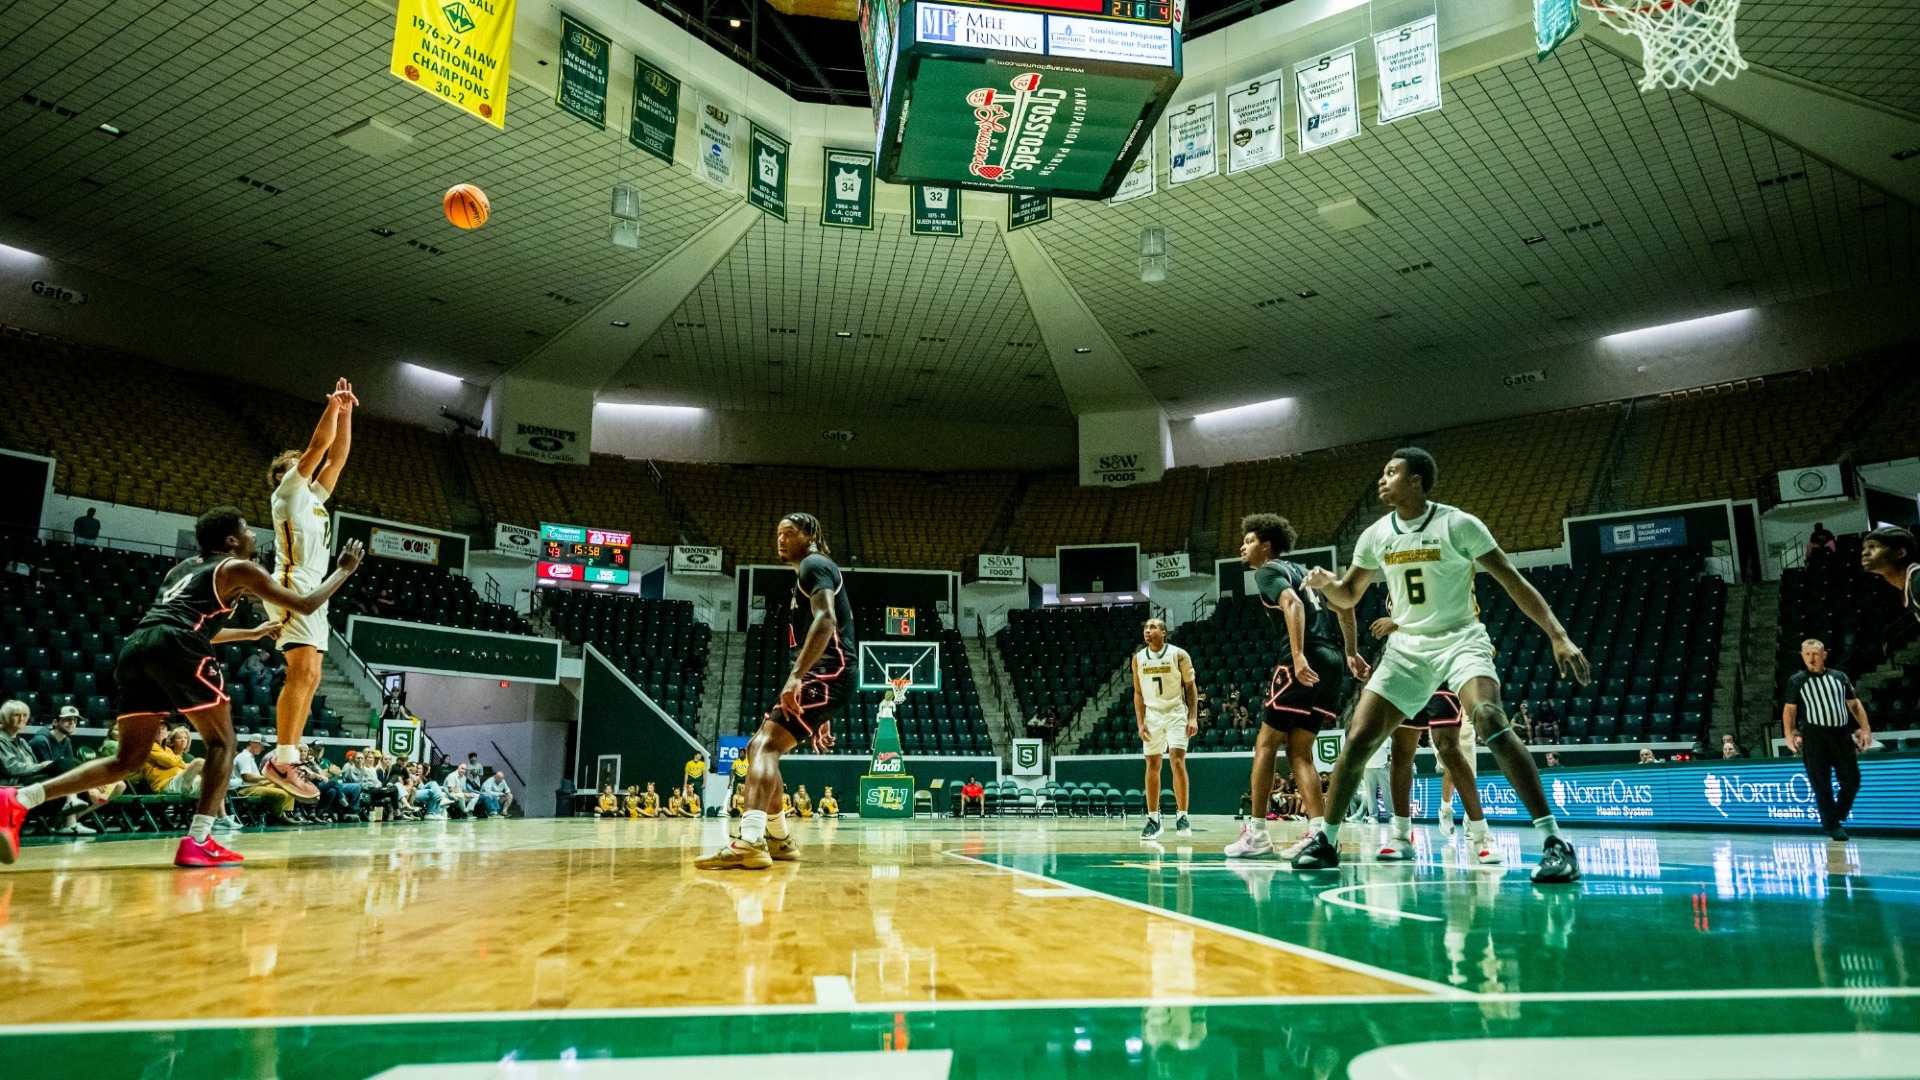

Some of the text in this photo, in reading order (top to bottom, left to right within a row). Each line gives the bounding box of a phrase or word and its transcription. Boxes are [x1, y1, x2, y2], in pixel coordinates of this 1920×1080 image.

[1112, 2, 1131, 17] 21
[1136, 4, 1145, 18] 0
[1160, 7, 1168, 19] 4
[966, 28, 1037, 49] PRINTING
[1399, 27, 1412, 42] S
[413, 15, 497, 70] 1976-77 AIAW
[422, 38, 484, 81] NATIONAL
[1382, 43, 1432, 62] Southeastern
[1389, 52, 1425, 66] Women's
[567, 50, 602, 75] Women's
[1318, 57, 1331, 71] S
[1389, 58, 1426, 73] Volleyball
[413, 52, 490, 100] CHAMPIONS
[563, 58, 605, 84] Basketball
[1248, 82, 1260, 95] S
[1301, 71, 1350, 92] Southeastern
[1309, 80, 1343, 95] Women's
[1391, 75, 1422, 91] SLC
[436, 81, 465, 104] 30-2
[1308, 86, 1344, 102] Volleyball
[1398, 94, 1419, 105] 2024
[642, 93, 672, 115] Women's
[1186, 104, 1196, 115] S
[1232, 96, 1277, 114] Southeastern
[637, 99, 675, 124] Basketball
[1238, 111, 1272, 126] Volleyball
[1239, 106, 1270, 119] Women's
[1172, 114, 1212, 130] Southeastern
[1179, 124, 1206, 134] Women's
[704, 122, 731, 141] Women's
[1011, 88, 1067, 171] Crossroads
[1039, 87, 1087, 176] TANGIPAHOA PARISH
[1177, 129, 1207, 142] Volleyball
[1255, 125, 1275, 136] SLC
[1320, 128, 1338, 139] 2023
[1246, 146, 1264, 156] 2023
[764, 164, 774, 177] 21
[1186, 166, 1201, 175] 2022
[842, 183, 854, 192] 34
[930, 192, 943, 201] 32
[32, 281, 88, 305] Gate 3
[1503, 370, 1547, 386] Gate 1
[517, 424, 576, 442] RONNIE'S
[822, 431, 856, 440] Gate 2
[1100, 455, 1138, 469] S&W
[1103, 472, 1135, 482] FOODS
[502, 525, 538, 539] RONNIE'S
[548, 547, 561, 557] 43
[574, 545, 600, 556] 15:58
[679, 547, 718, 556] RONNIE'S
[615, 555, 623, 564] 18
[988, 556, 1014, 566] S&W
[1156, 556, 1180, 568] S&W
[1158, 570, 1179, 579] FOODS
[1405, 568, 1426, 604] 6
[901, 619, 910, 634] 6
[1152, 677, 1163, 695] 7
[394, 733, 408, 750] S
[1022, 749, 1032, 762] S
[1323, 741, 1336, 757] S
[1597, 806, 1653, 819] Health System
[1768, 806, 1804, 819] Health
